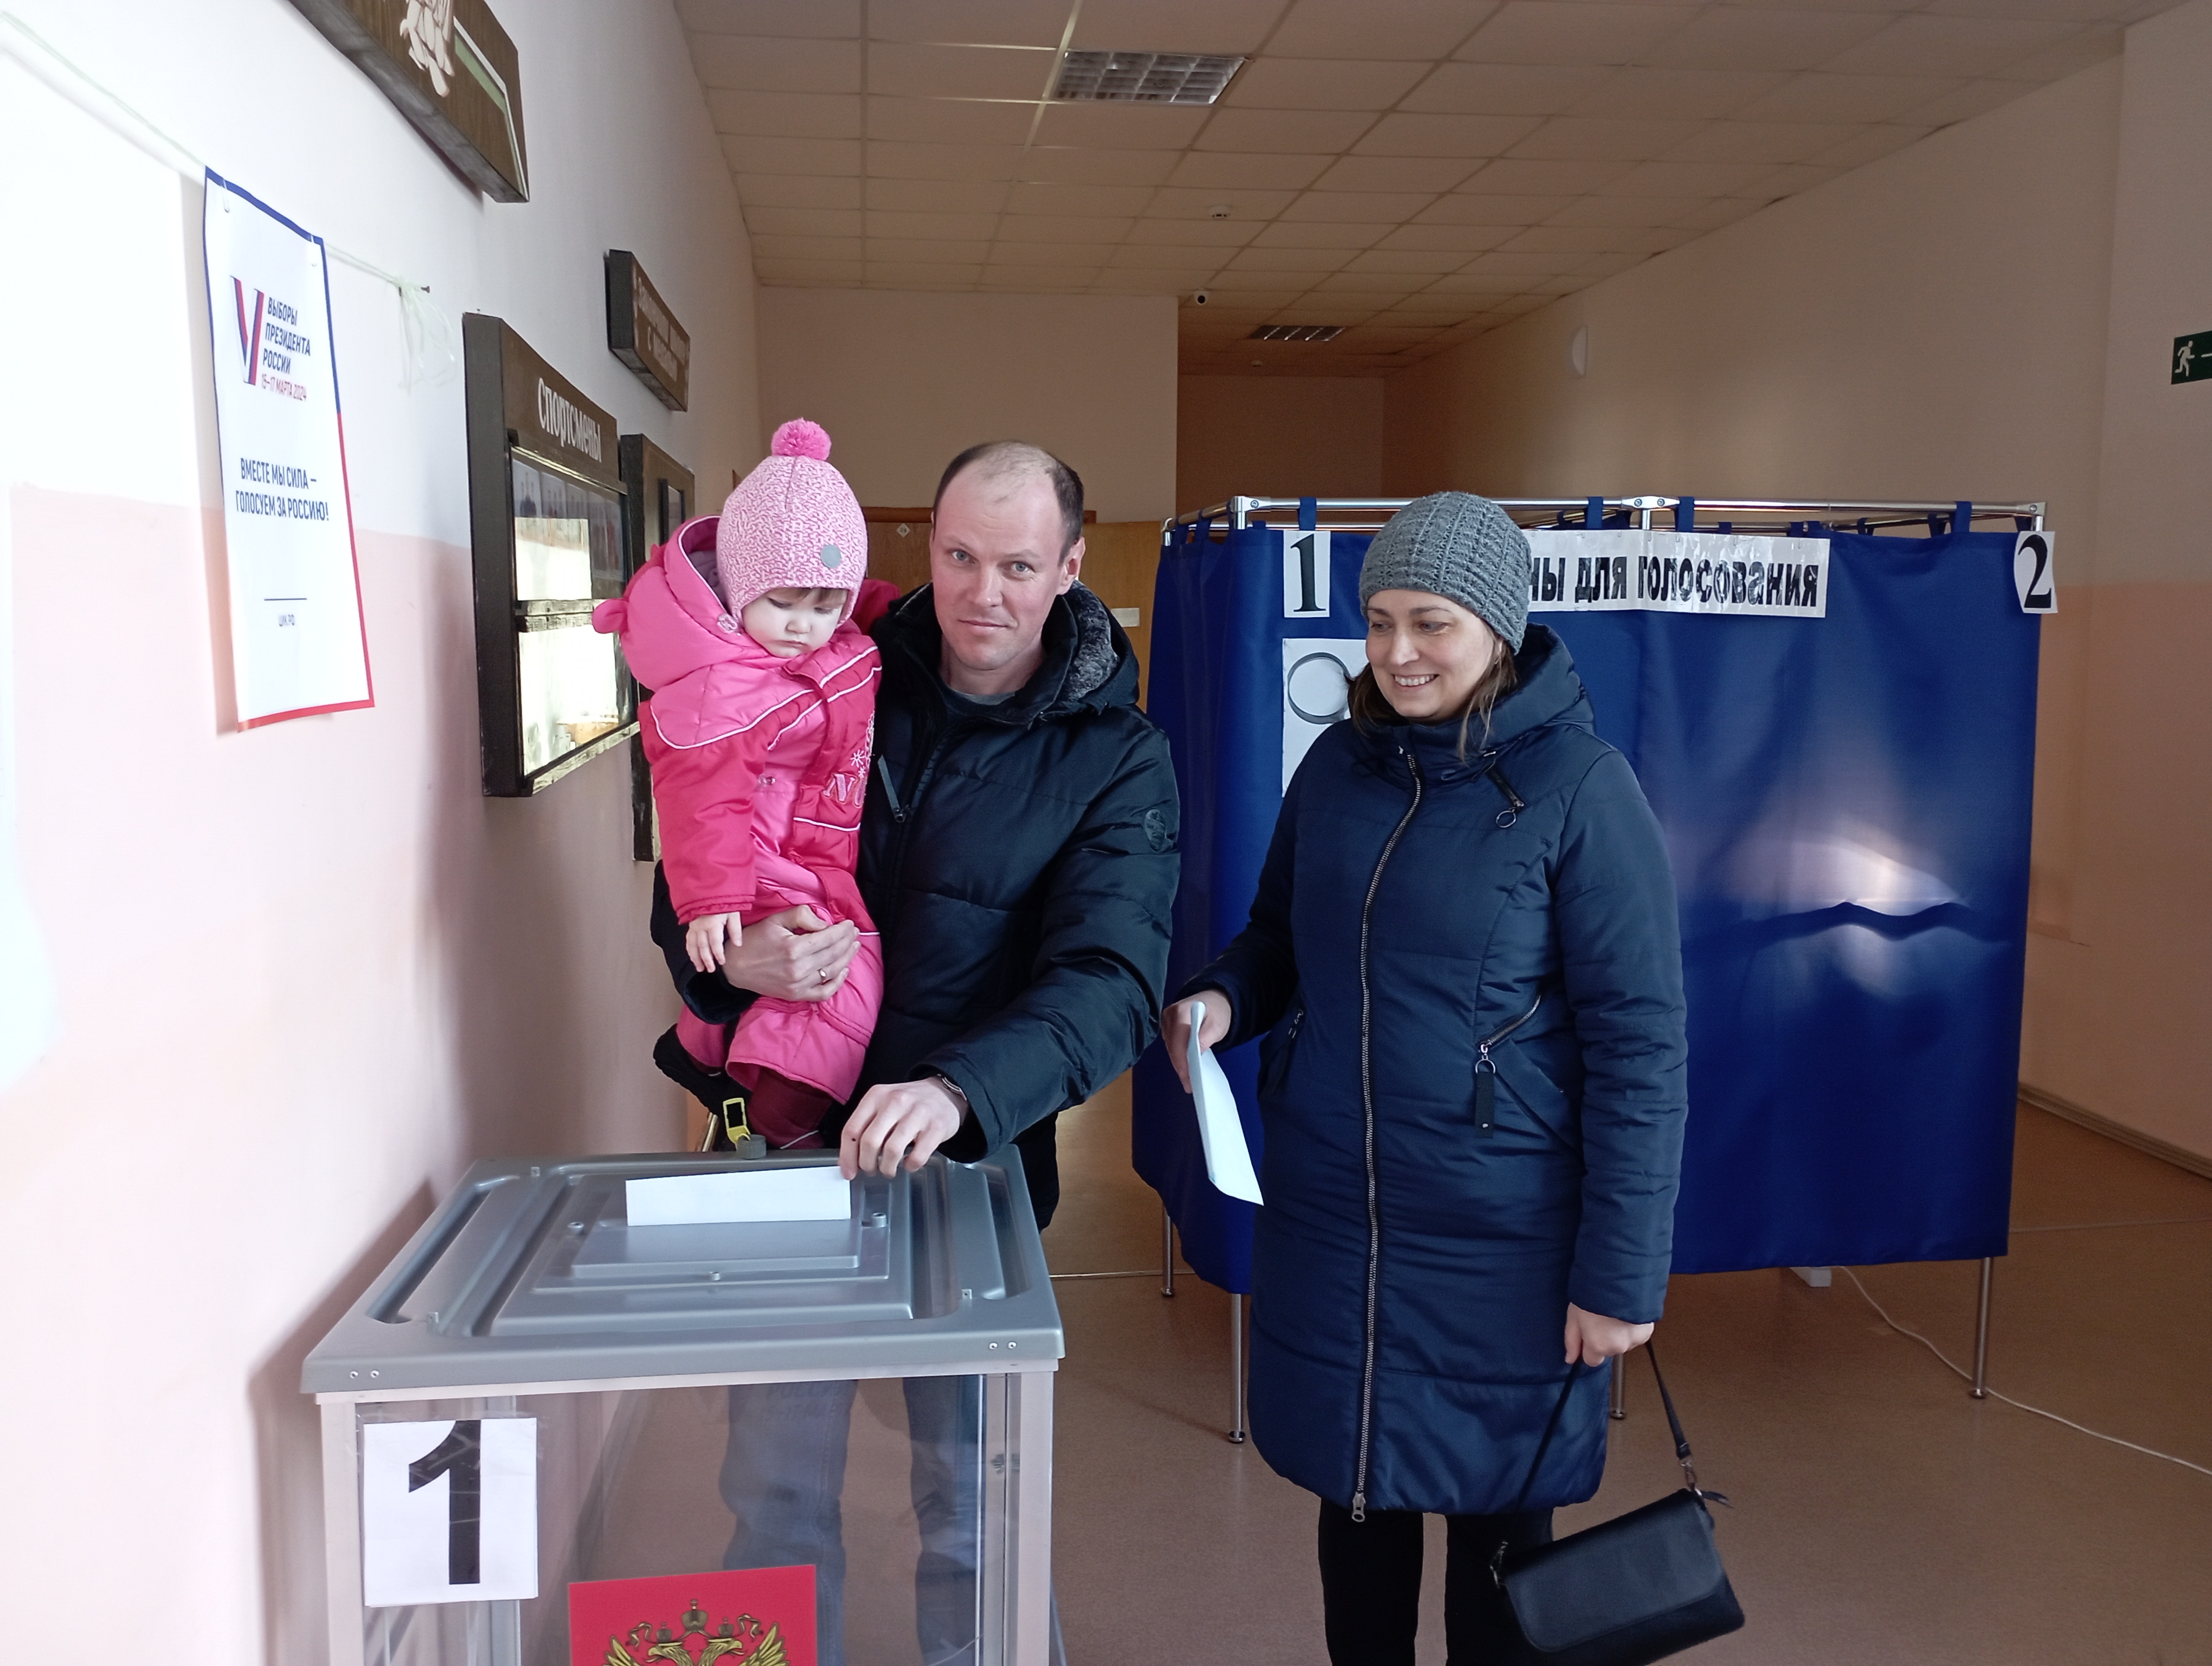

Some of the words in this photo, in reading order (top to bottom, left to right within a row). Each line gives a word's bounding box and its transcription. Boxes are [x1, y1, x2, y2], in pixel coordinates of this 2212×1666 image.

[267, 297, 298, 326] ВЫБОРЫ
[265, 322, 311, 356] ПРЕЗИДЕНТА
[263, 348, 291, 374] РОССИИ
[240, 457, 270, 484] ВМЕСТЕ
[272, 464, 285, 485] МЫ
[286, 466, 309, 489] СИЛА
[235, 490, 276, 516] ГОЛОСУЕМ
[277, 496, 287, 517] ЗА
[287, 497, 329, 521] РОССИЮ!
[1290, 533, 1327, 613] 1
[2017, 534, 2052, 608] 2
[408, 1419, 481, 1585] 1
